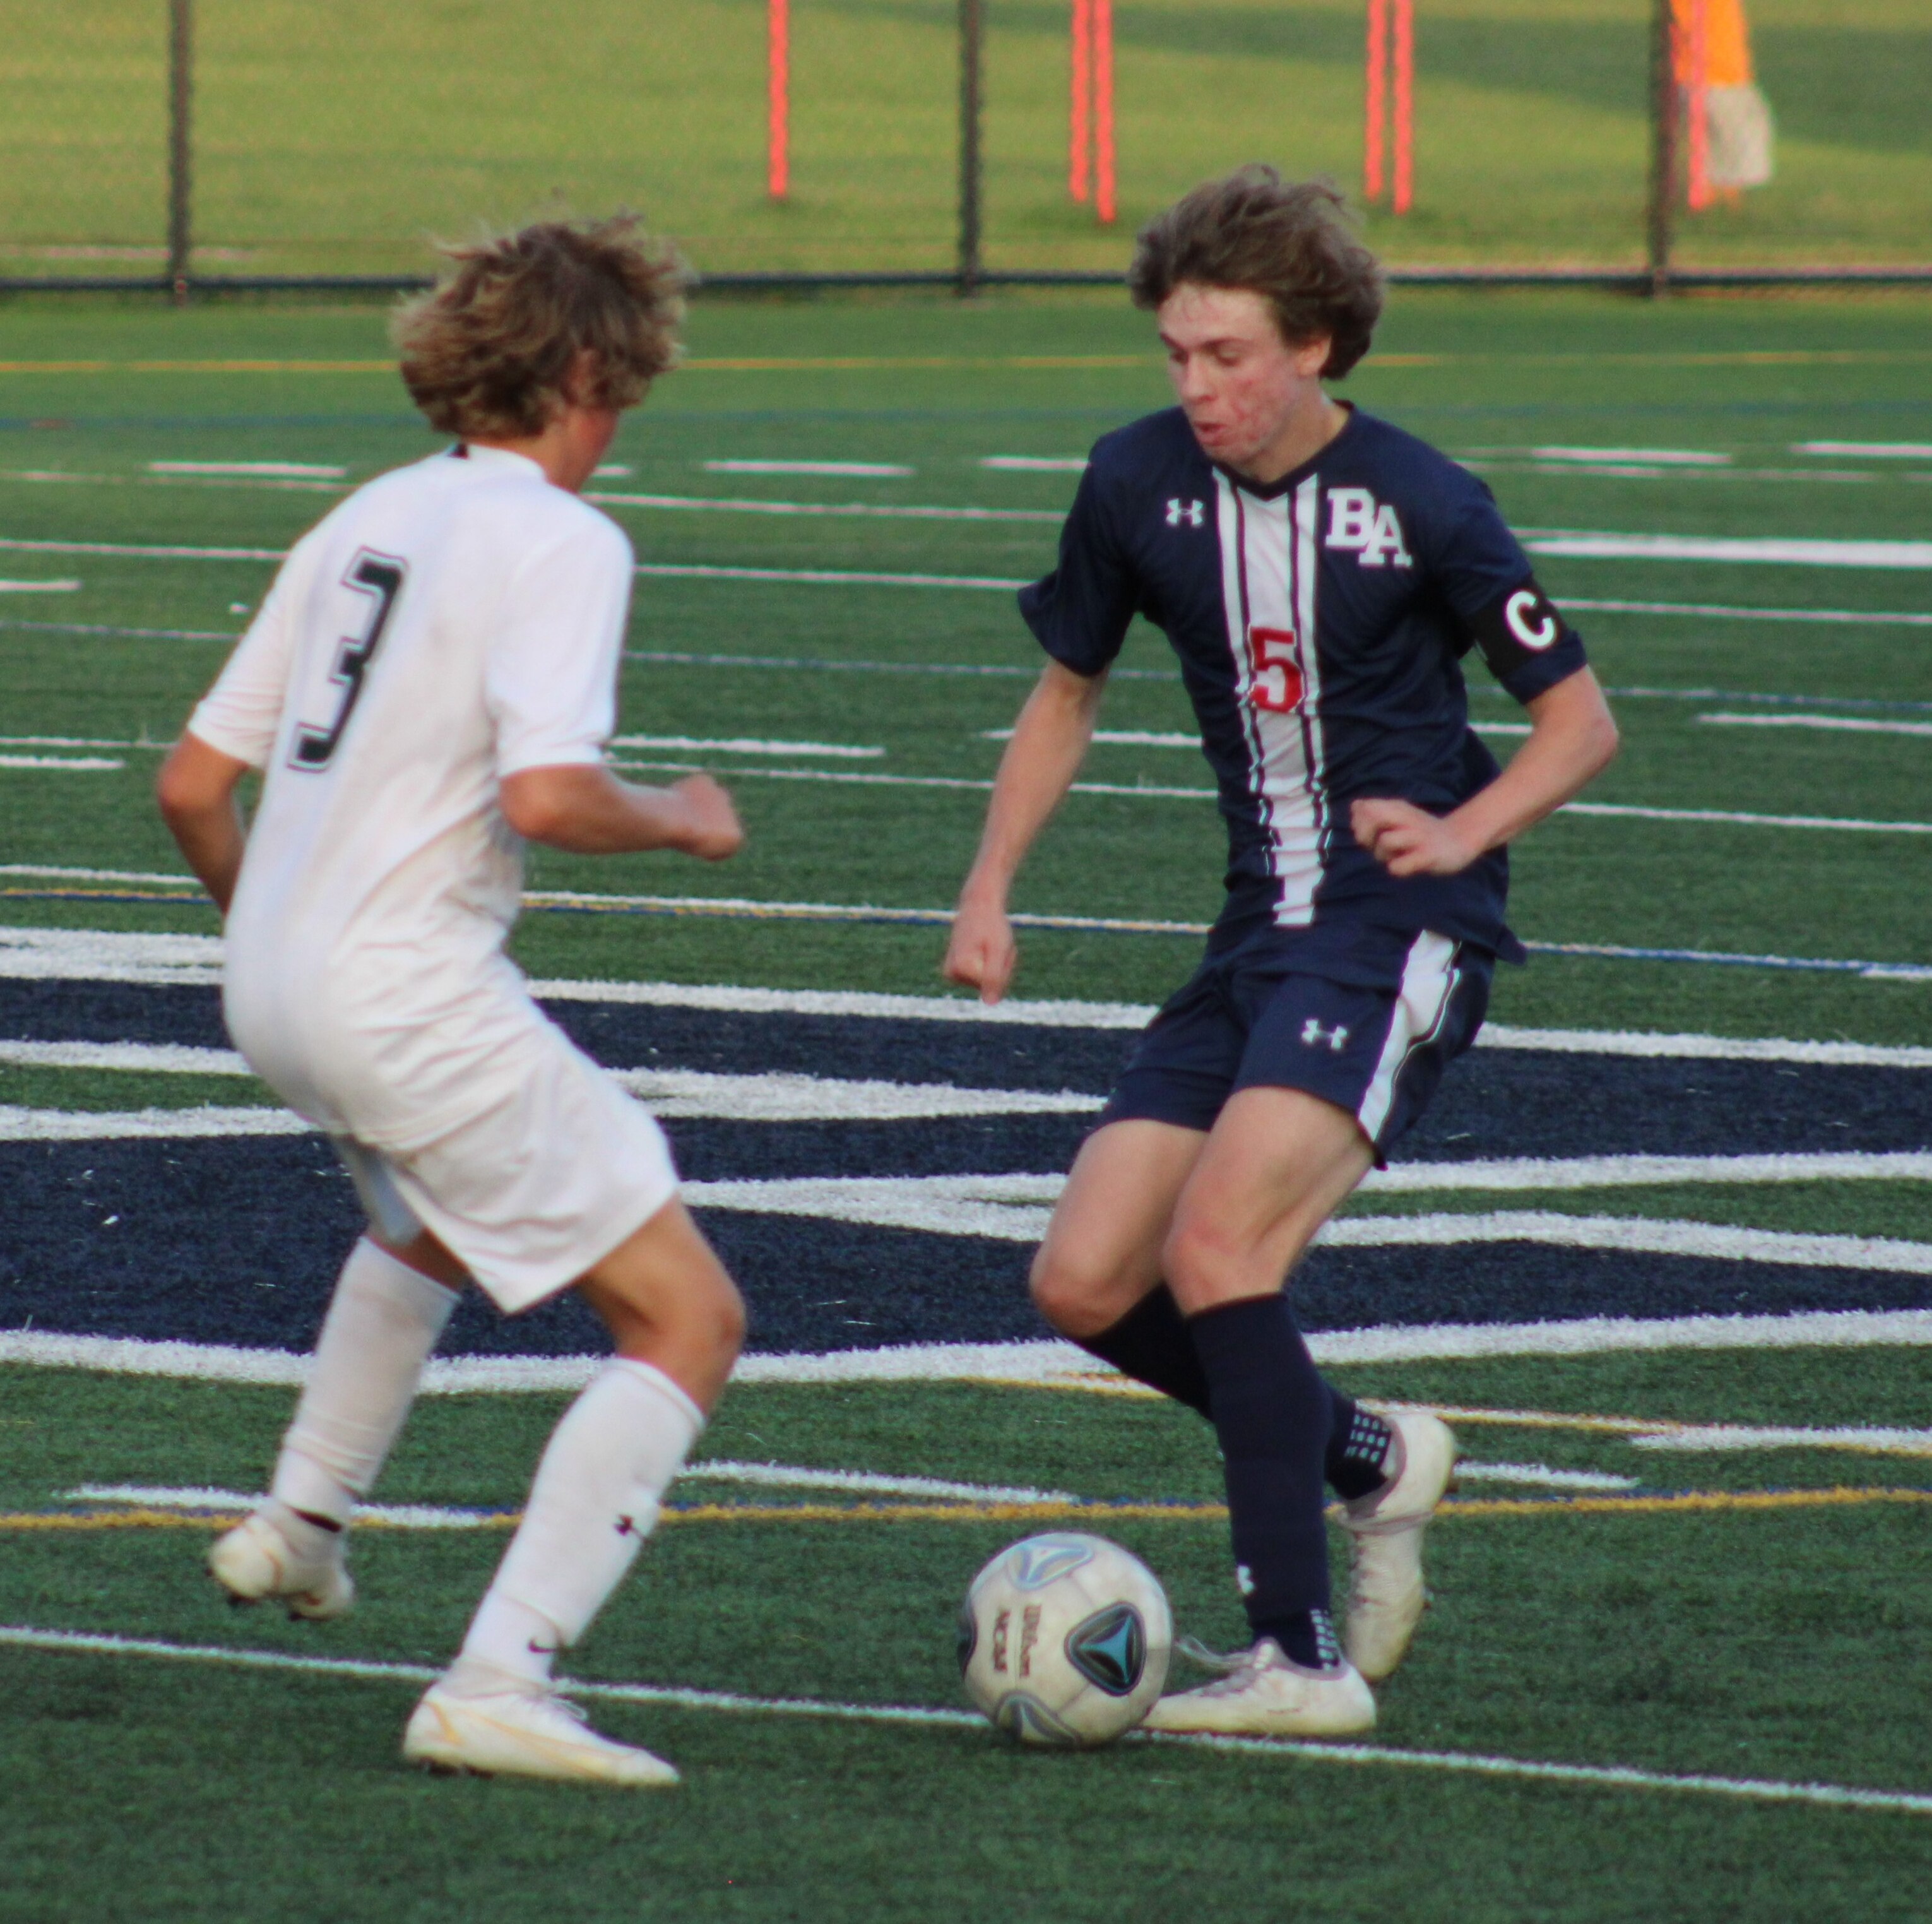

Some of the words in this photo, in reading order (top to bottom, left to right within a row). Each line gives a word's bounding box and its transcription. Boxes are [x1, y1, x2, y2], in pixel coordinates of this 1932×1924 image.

[1325, 487, 1413, 567] BA
[286, 545, 410, 773] 3
[1506, 591, 1555, 650] C
[1249, 626, 1303, 713] 5
